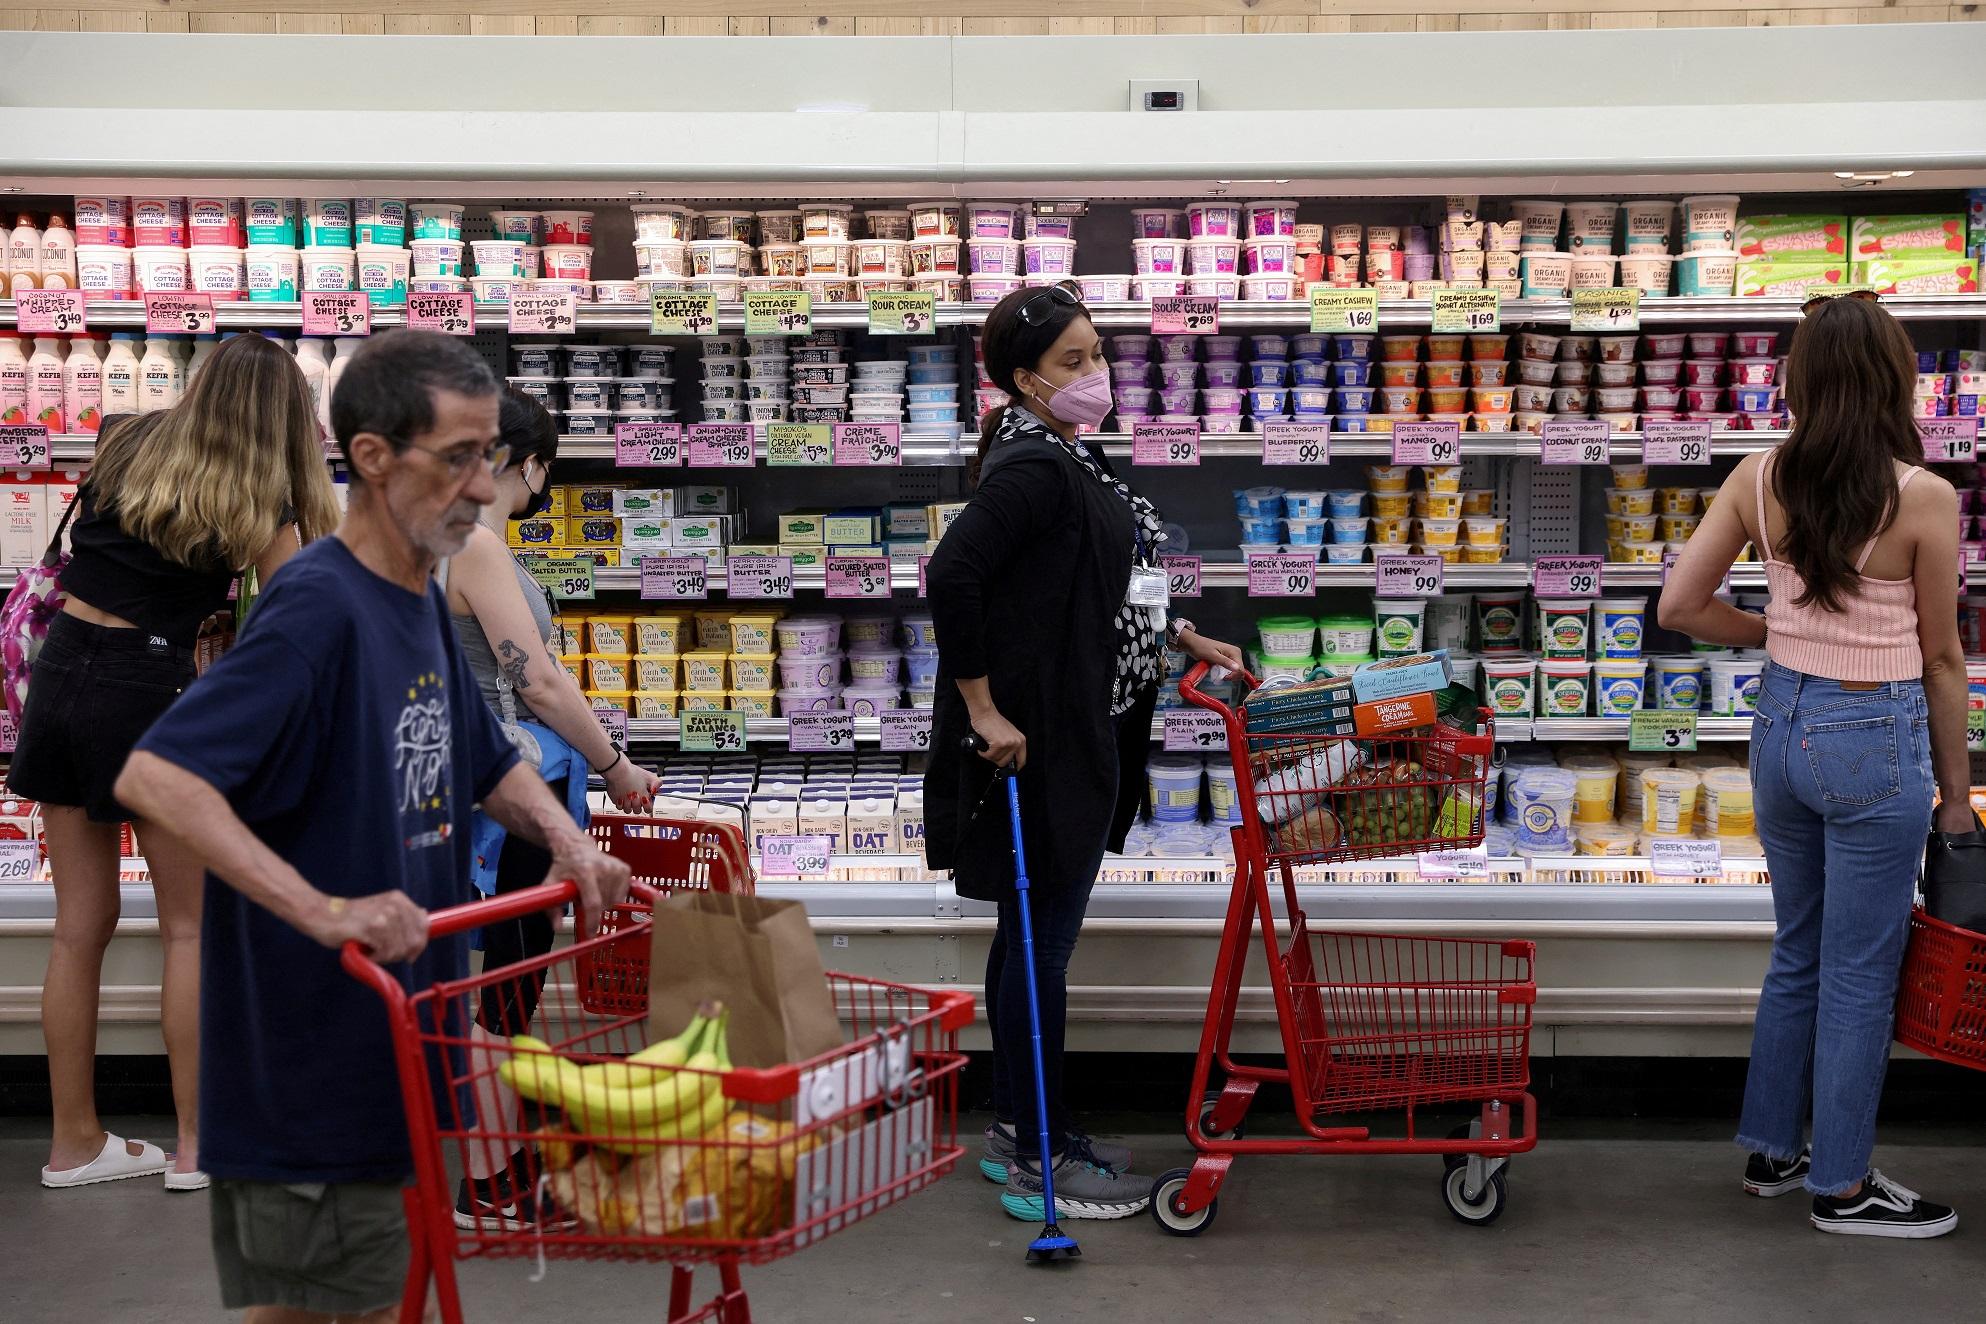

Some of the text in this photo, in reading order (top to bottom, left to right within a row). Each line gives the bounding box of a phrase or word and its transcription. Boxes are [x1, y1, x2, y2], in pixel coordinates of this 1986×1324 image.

[1694, 212, 1727, 220] ORGANIC
[1633, 217, 1665, 226] ORGANIC
[1534, 269, 1565, 277] ORGANIC
[1575, 273, 1606, 281] ORGANIC
[19, 299, 75, 307] WHIPPED
[411, 300, 463, 308] COTTAGE
[514, 299, 567, 307] COTTAGE
[656, 300, 708, 309] COTTAGE
[872, 301, 930, 310] SOUR CREAM
[1314, 297, 1373, 306] CREAMY CASHEW
[152, 302, 197, 310] COTTAGE
[1154, 303, 1216, 314] SOUR CREAM
[151, 311, 182, 319] CHEESE
[316, 307, 348, 315] CHEESE
[418, 309, 459, 317] CHEESE
[663, 309, 703, 317] CHEESE
[845, 426, 881, 436] CRÈME
[1136, 428, 1164, 437] GREEK
[1923, 426, 1955, 435] SKYR
[620, 439, 650, 447] CREAM
[772, 439, 806, 447] CREAM
[829, 563, 861, 571] CULTURED
[1251, 560, 1313, 569] GREEK YOGURT
[1538, 561, 1568, 571] GREEK
[1385, 567, 1420, 576] HONEY
[1374, 703, 1411, 717] TANGERINE
[691, 717, 727, 725] EARTH
[792, 716, 852, 725] GREEK YOGURT
[881, 716, 907, 724] GREEK
[1167, 718, 1225, 727] GREEK YOGURT
[853, 834, 888, 848] OAT
[768, 844, 794, 855] OAT
